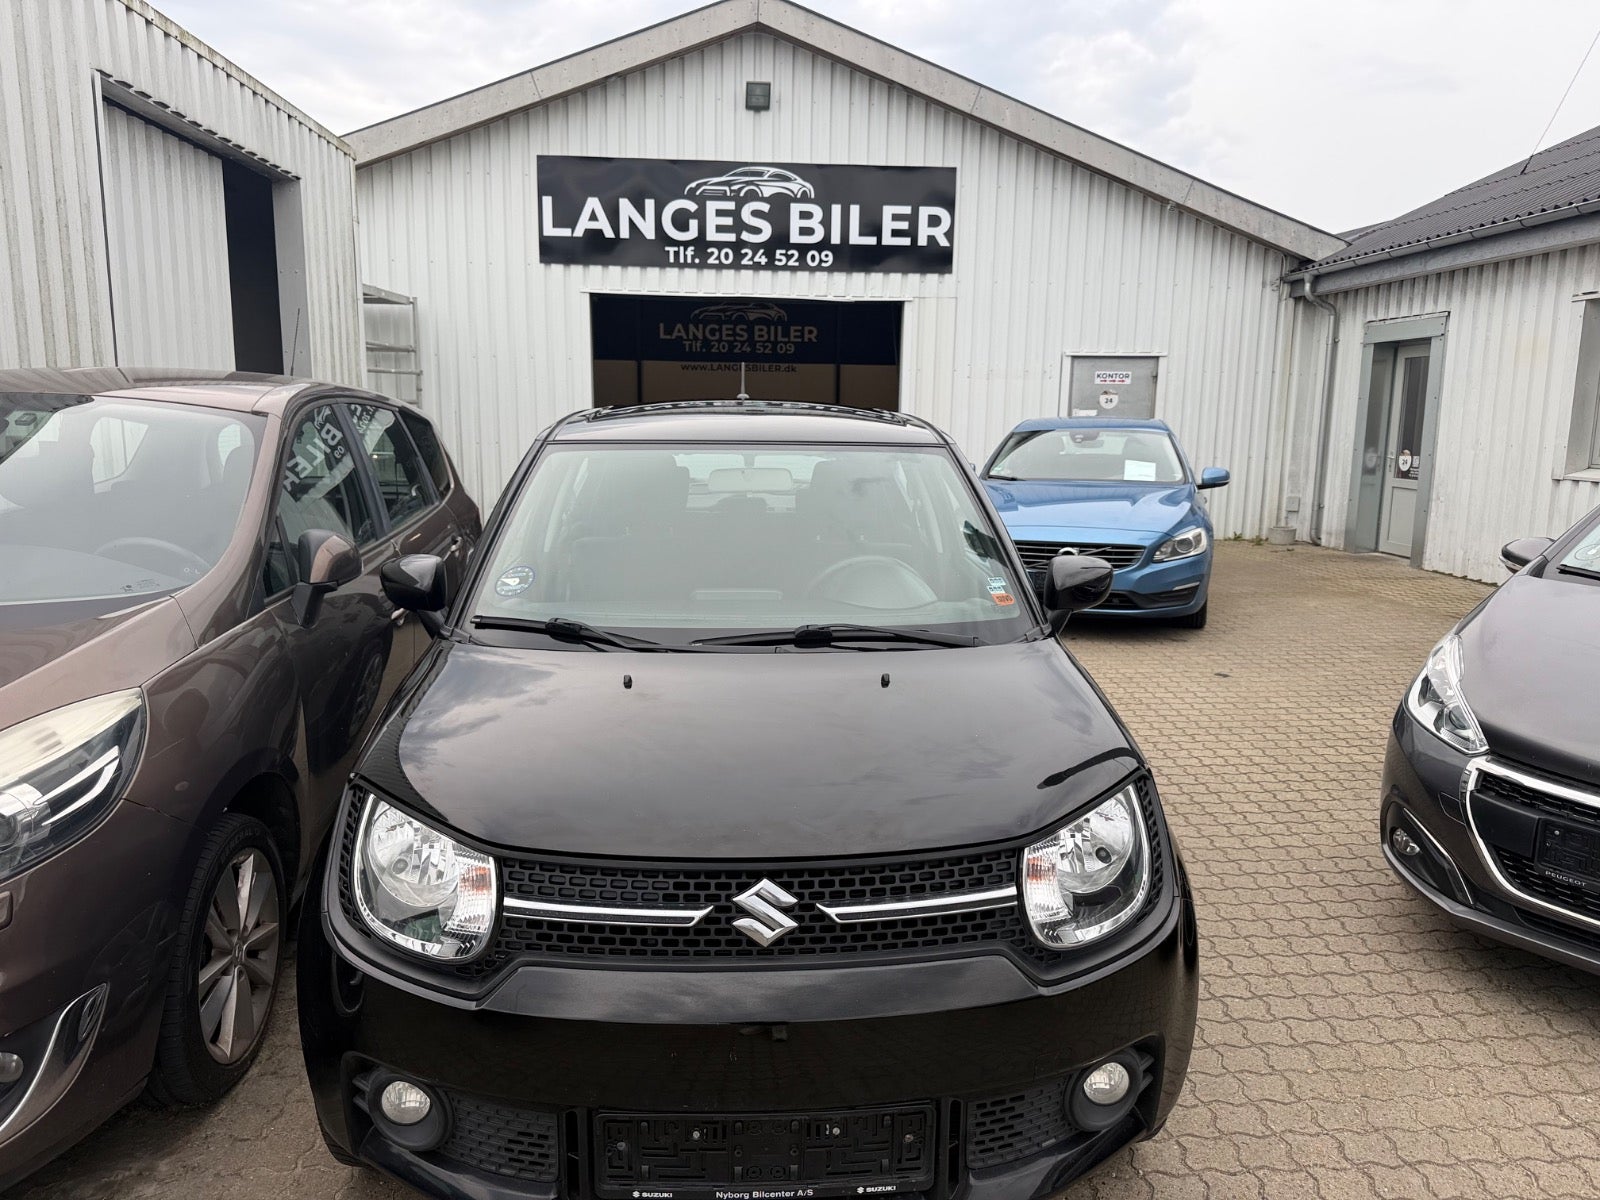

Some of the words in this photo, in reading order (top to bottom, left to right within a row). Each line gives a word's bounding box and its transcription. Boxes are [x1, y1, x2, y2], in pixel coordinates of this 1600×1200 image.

[541, 195, 773, 244] LANGES
[789, 202, 952, 247] BILER
[665, 246, 700, 264] Tlf.
[706, 247, 734, 265] 20
[740, 248, 768, 266] 24
[774, 249, 800, 267] 52
[806, 250, 834, 268] 09
[659, 322, 748, 341] LANGES
[754, 325, 818, 343] BILER
[683, 341, 706, 352] Tlf.
[710, 342, 728, 353] 20
[733, 342, 751, 353] 24
[755, 343, 773, 354] 52
[777, 343, 795, 354] 09
[1545, 870, 1587, 887] PEUGEOT
[716, 1191, 750, 1199] Nyborg
[752, 1190, 795, 1198] Bilcenter
[796, 1189, 814, 1197] A/S
[866, 1185, 897, 1193] SUZUKI
